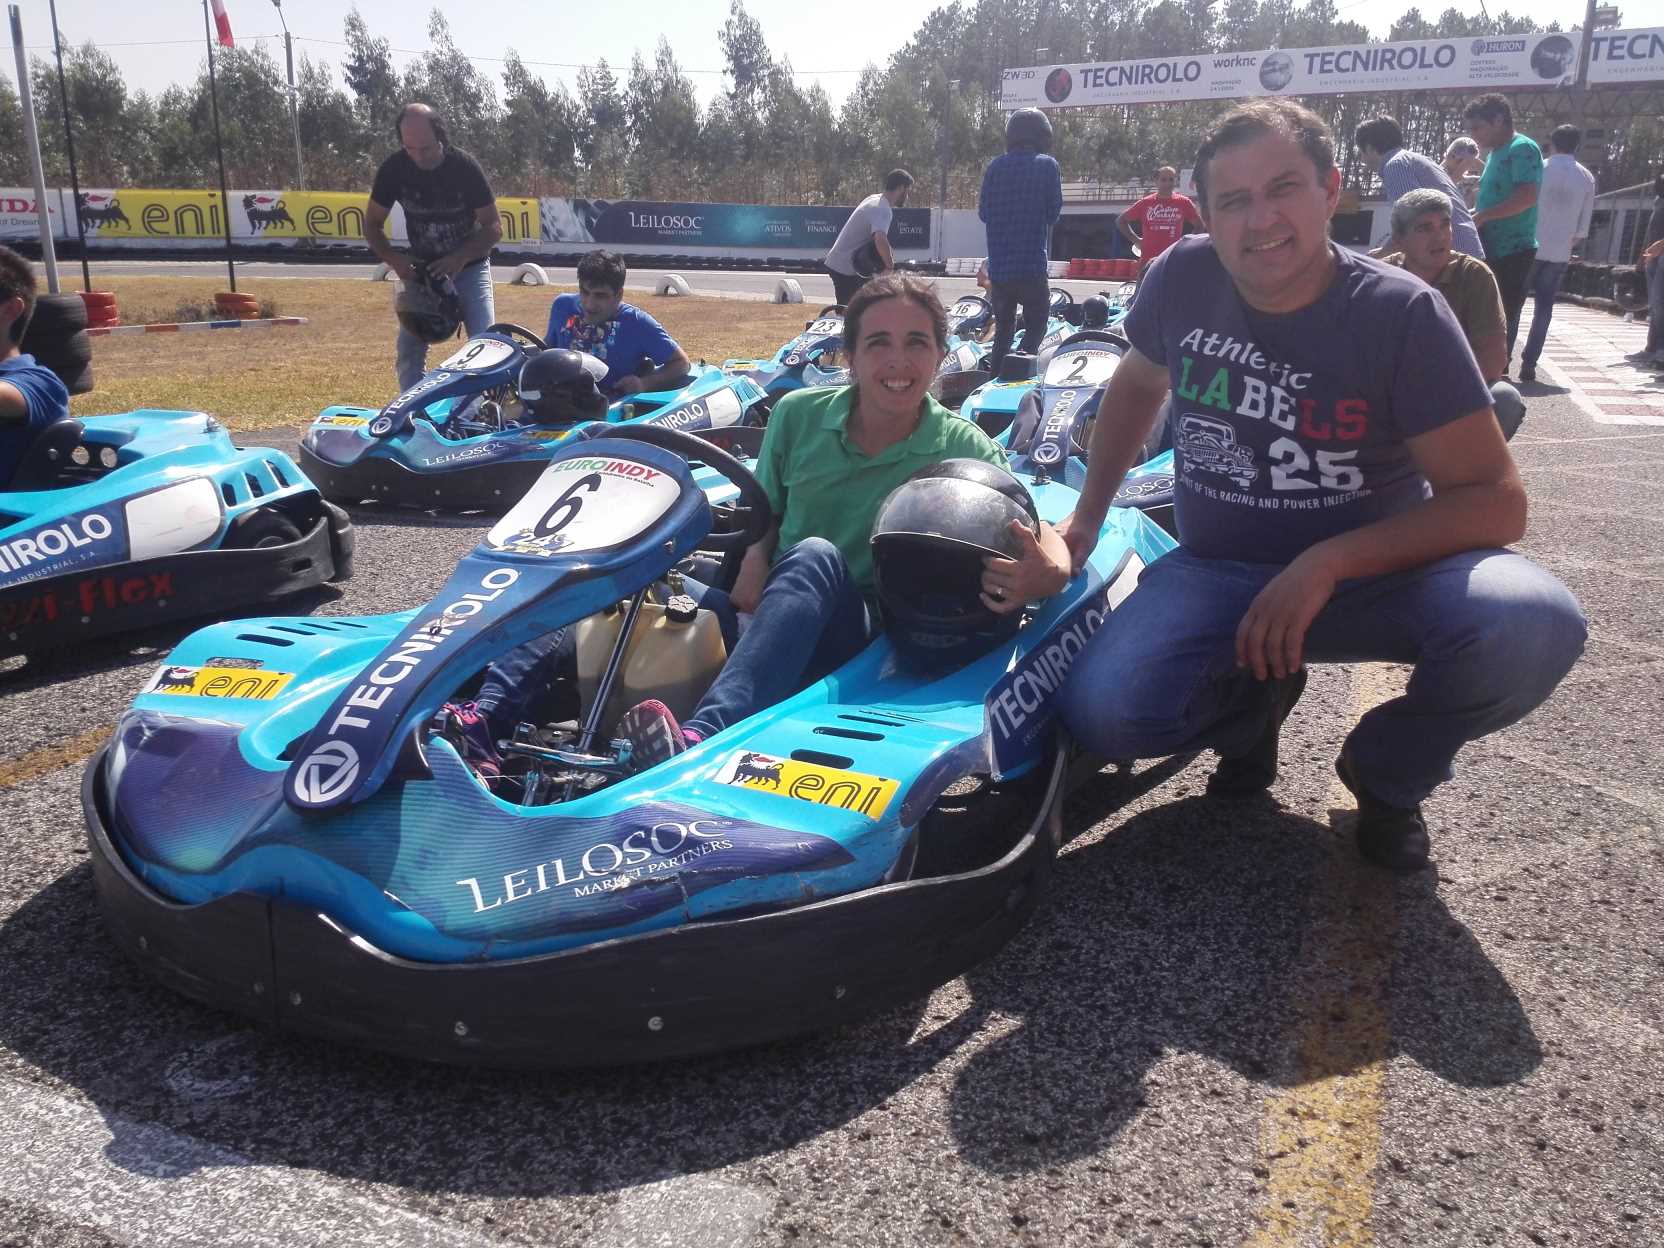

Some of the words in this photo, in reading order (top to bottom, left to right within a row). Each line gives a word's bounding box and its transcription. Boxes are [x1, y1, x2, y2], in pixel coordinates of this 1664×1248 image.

[1213, 55, 1257, 69] worknc
[1304, 44, 1456, 75] TECNIROLO
[1079, 60, 1202, 89] TECNIROLO
[142, 193, 222, 236] eni
[306, 205, 366, 236] en
[499, 201, 529, 240] ni
[628, 211, 704, 229] LEILOSOC
[764, 224, 792, 233] ATIVOS
[807, 224, 838, 233] FINANCE
[955, 304, 971, 314] 16
[814, 321, 836, 332] 23
[457, 344, 485, 365] 9
[1180, 328, 1312, 389] Athletic
[1068, 356, 1088, 383] 2
[652, 403, 704, 430] NIROLO
[553, 459, 660, 481] EUROINDY
[1269, 436, 1364, 490] 25
[533, 473, 602, 538] 6
[1204, 486, 1218, 500] THE
[1220, 491, 1255, 506] RACING
[1258, 498, 1279, 509] AND
[1283, 498, 1320, 509] POWER
[1323, 489, 1372, 507] INJECTION
[329, 568, 519, 736] TECNIROLO
[200, 672, 287, 699] eni
[989, 608, 1105, 740] TECNIROLO
[789, 775, 888, 814] eni
[456, 820, 726, 913] LEILOSOC
[649, 839, 734, 874] PARTNERS
